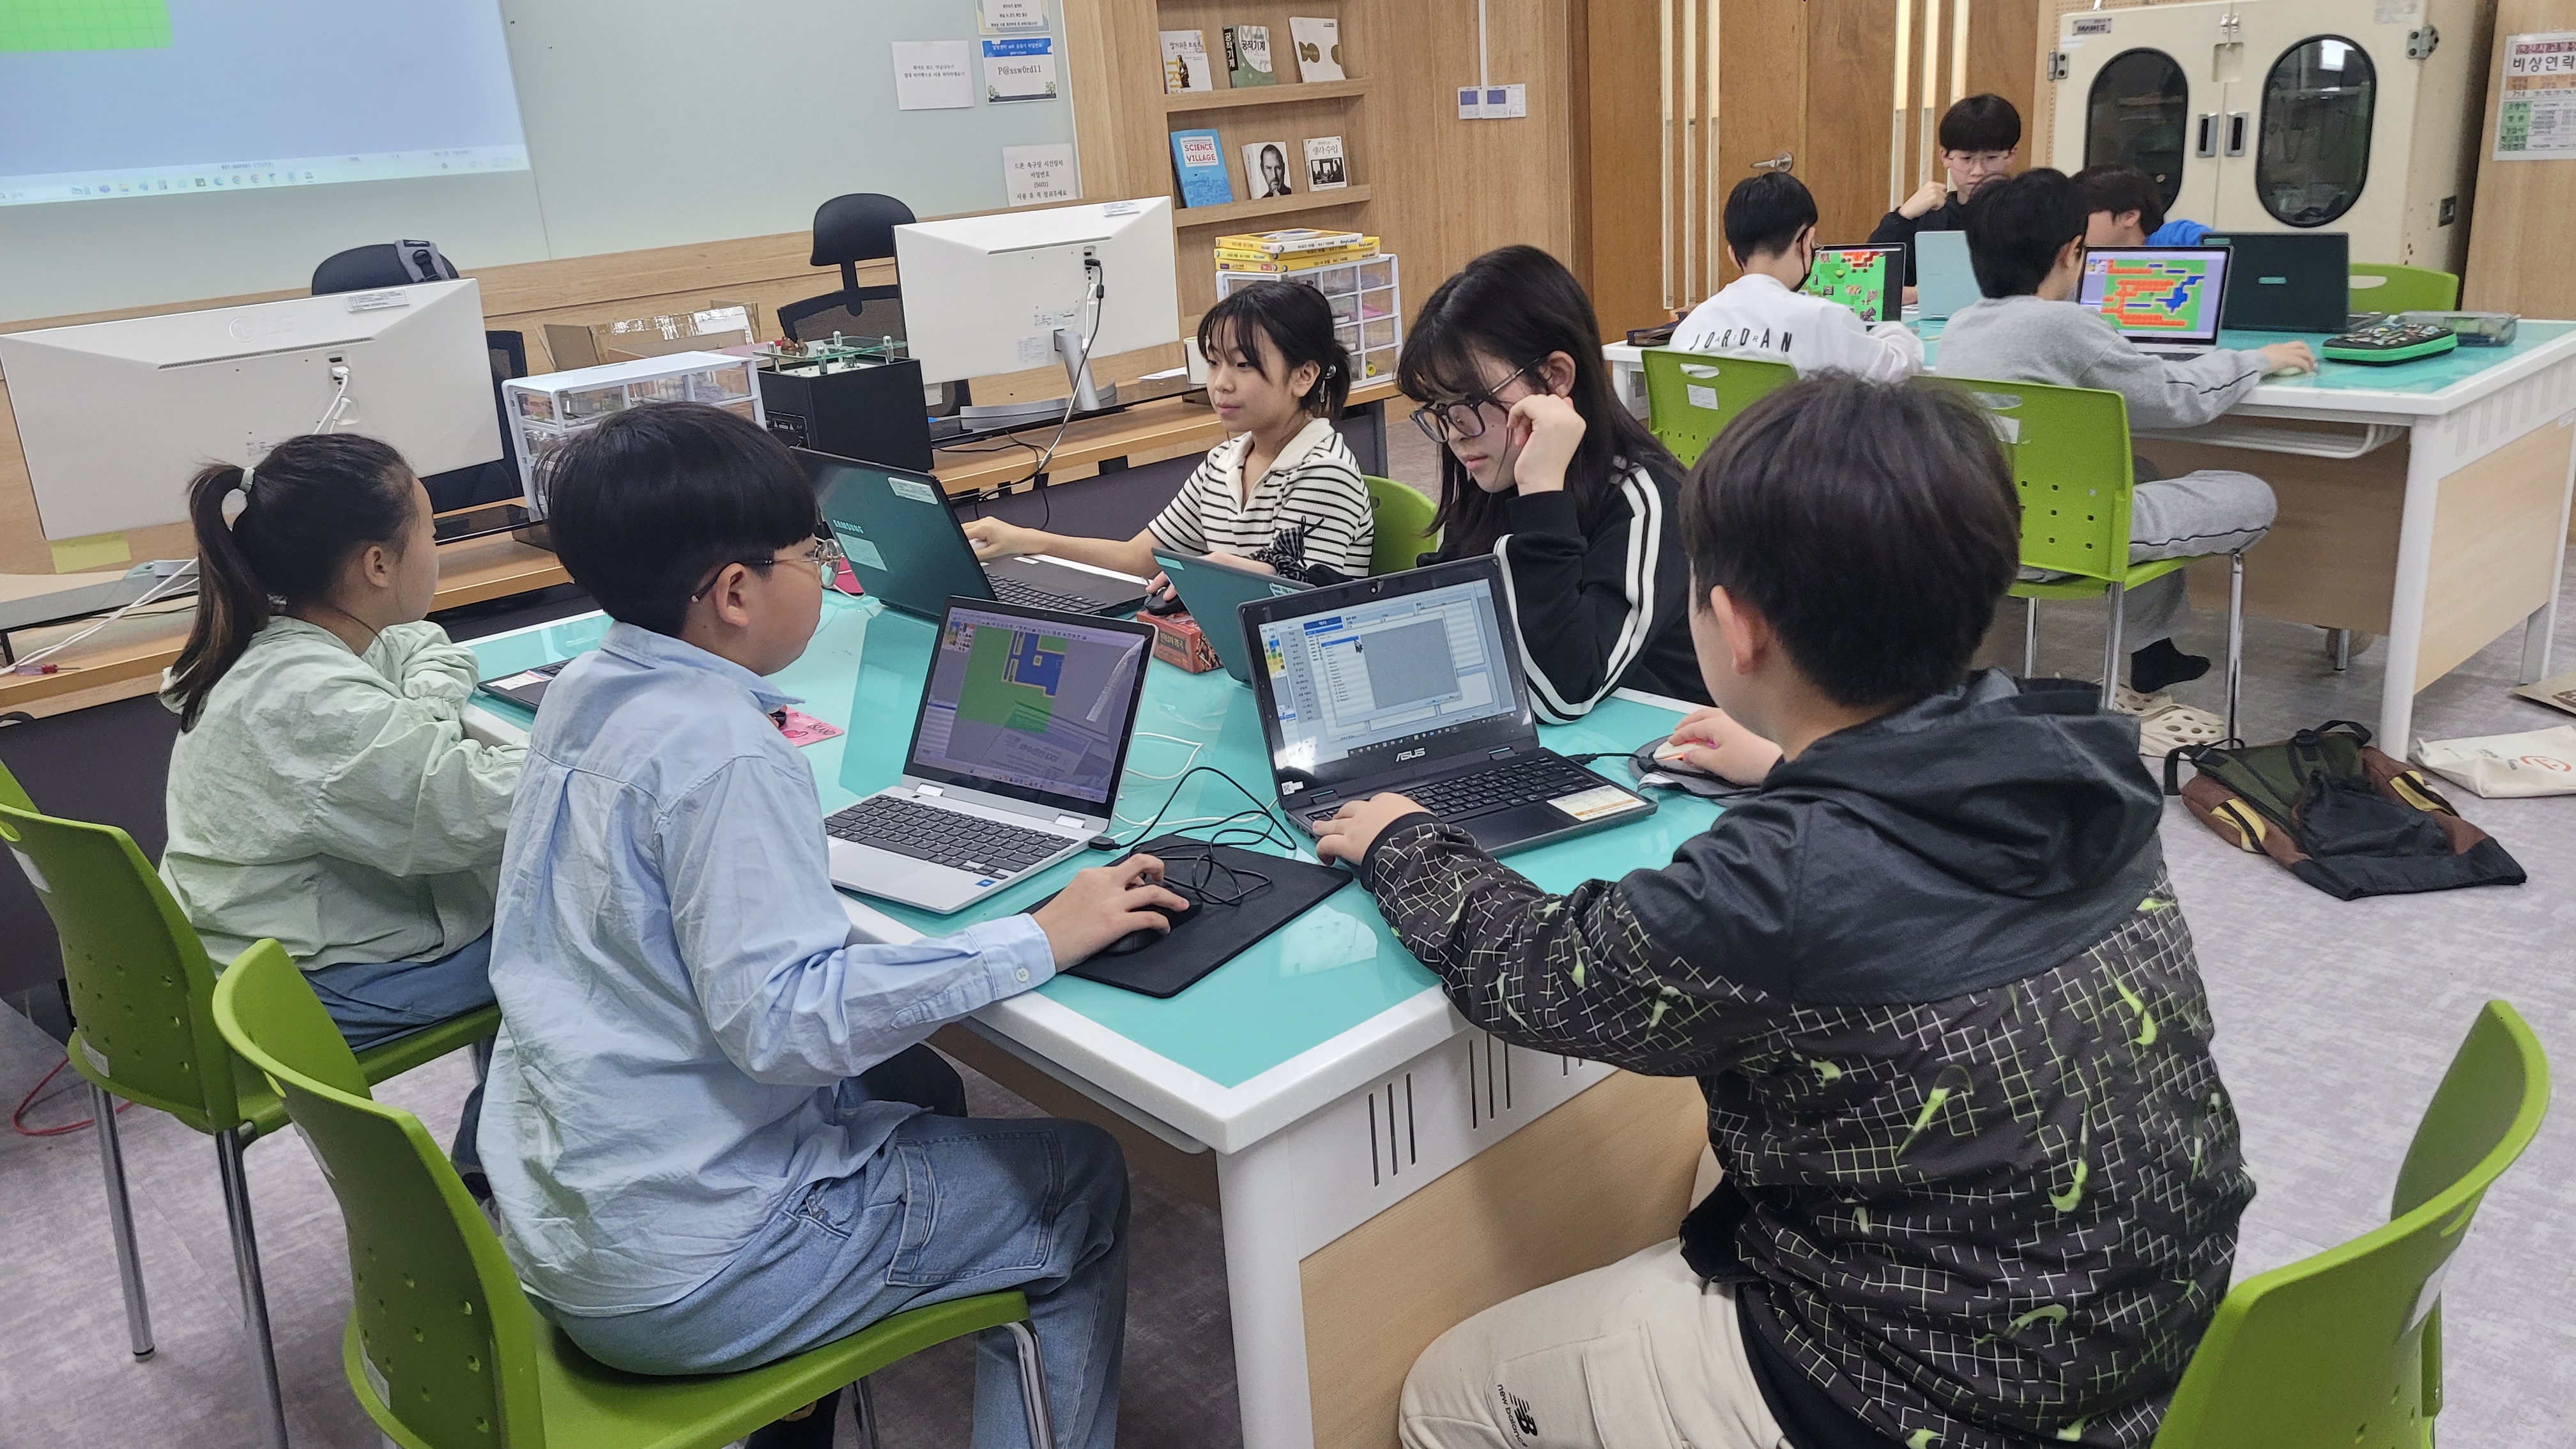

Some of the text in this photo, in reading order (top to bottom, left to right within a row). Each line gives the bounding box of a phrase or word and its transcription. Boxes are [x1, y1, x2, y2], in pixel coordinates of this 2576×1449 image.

[1170, 41, 1188, 50] 알기쉬운
[1224, 32, 1236, 68] 공작기계
[1241, 40, 1266, 51] 공작기계
[1184, 143, 1214, 152] SCIENCE
[1186, 154, 1216, 162] VILLAGE
[1689, 328, 1793, 353] JORDAN
[832, 519, 864, 534] SAMSUNG
[1395, 747, 1426, 763] ASUS
[1497, 1384, 1508, 1406] new
